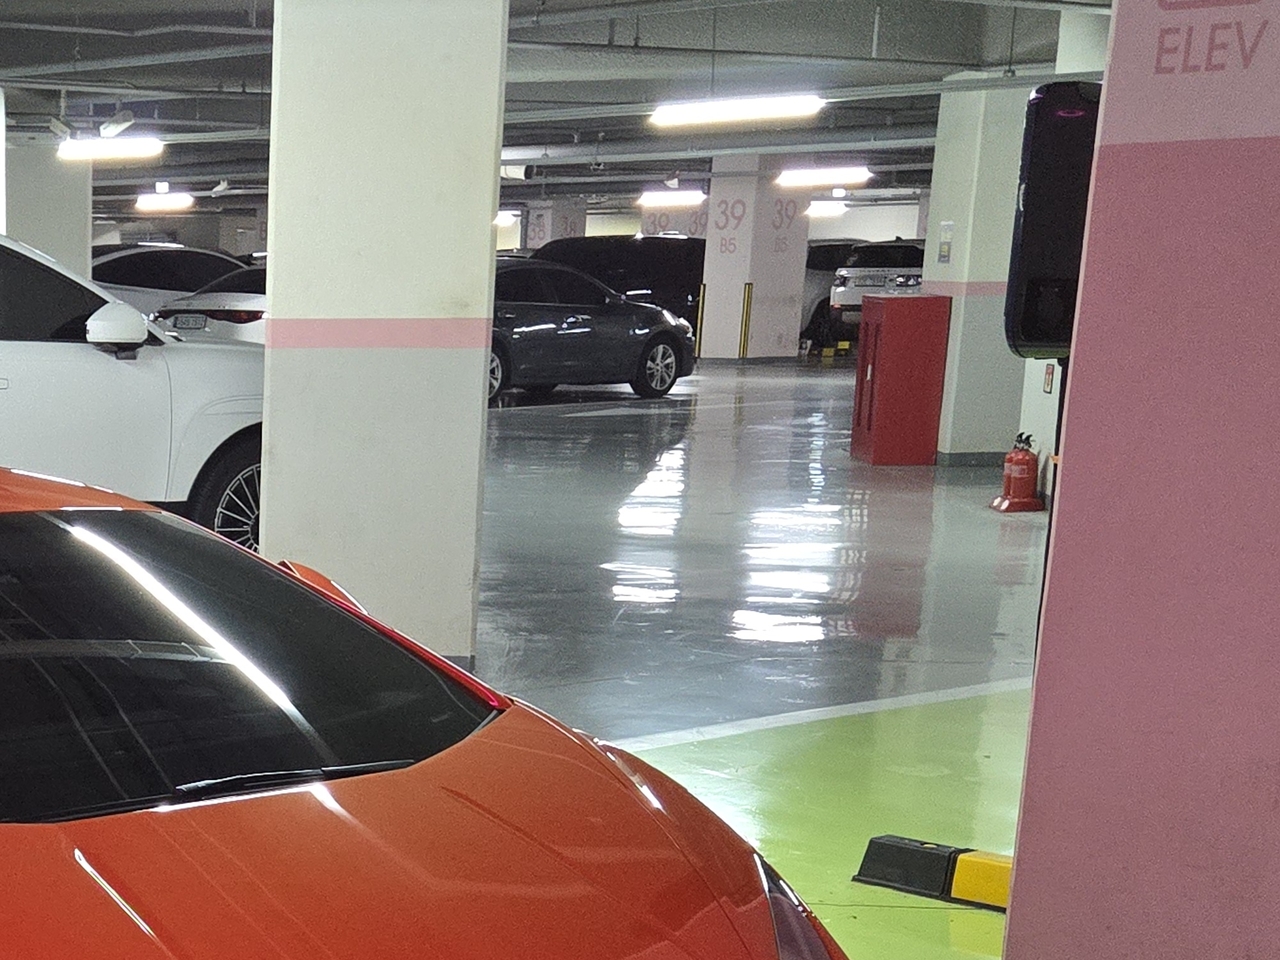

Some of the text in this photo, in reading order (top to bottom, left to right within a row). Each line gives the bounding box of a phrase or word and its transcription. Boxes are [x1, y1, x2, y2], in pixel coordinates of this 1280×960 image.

[1155, 19, 1269, 74] ELEV
[715, 199, 747, 230] 39
[772, 198, 798, 230] 39
[720, 237, 737, 254] B5
